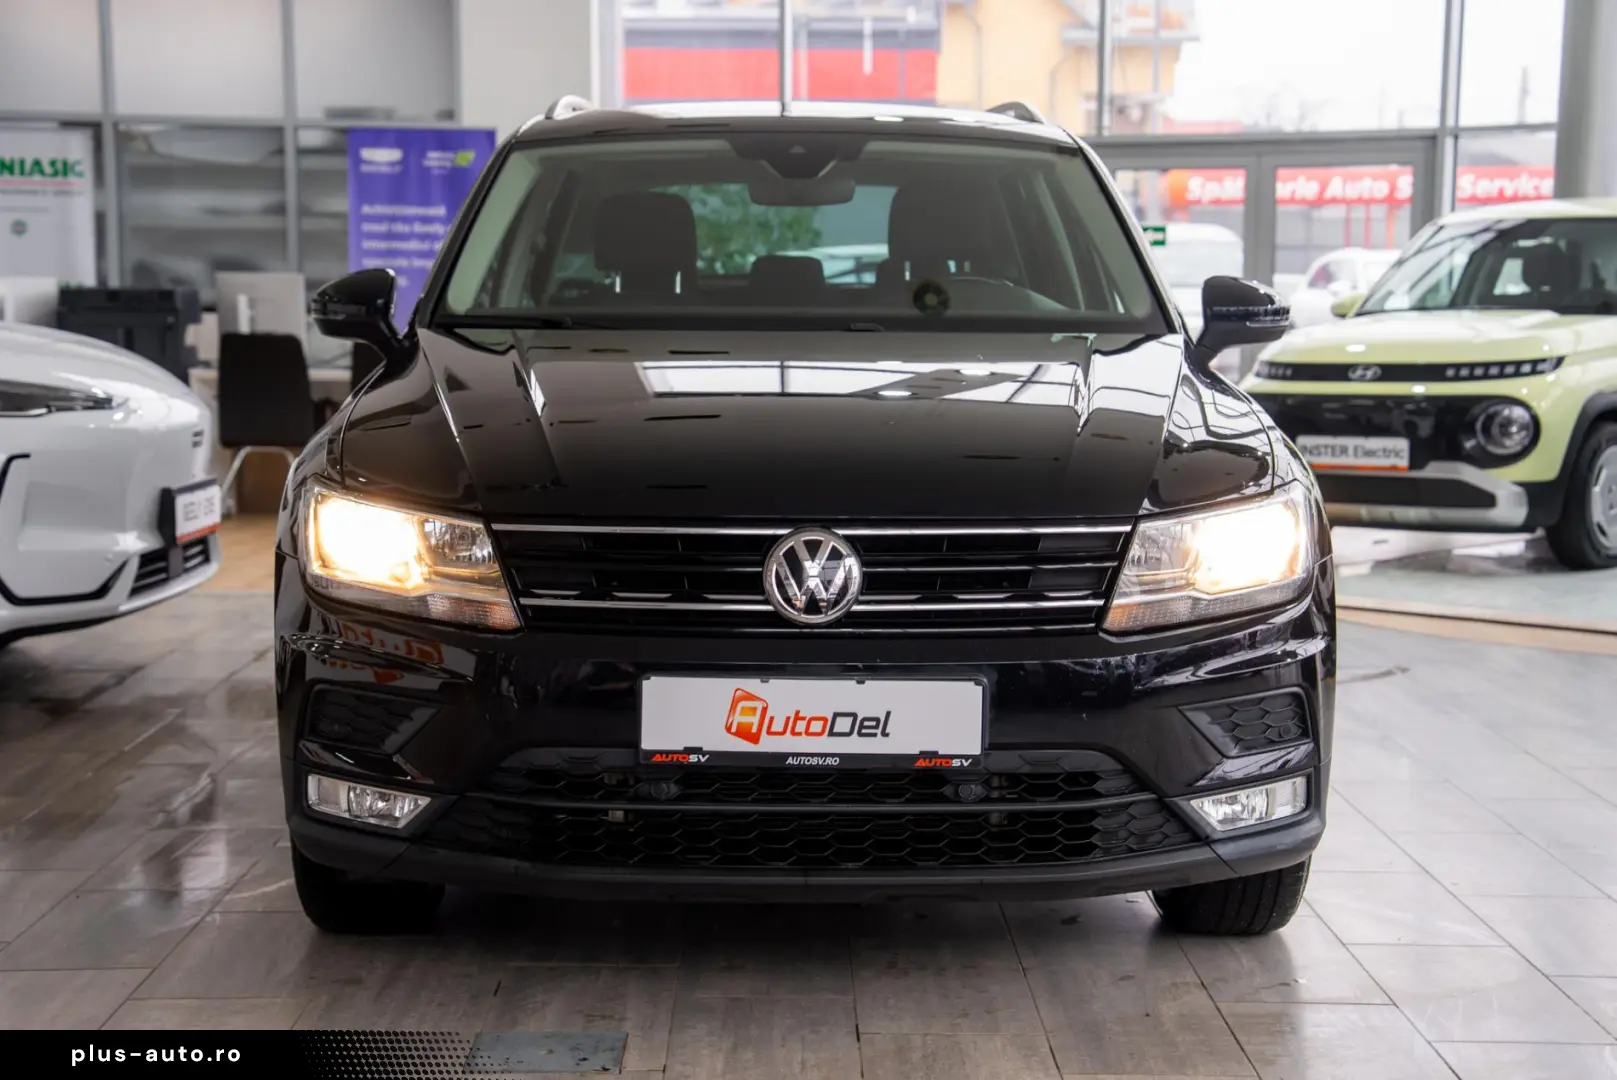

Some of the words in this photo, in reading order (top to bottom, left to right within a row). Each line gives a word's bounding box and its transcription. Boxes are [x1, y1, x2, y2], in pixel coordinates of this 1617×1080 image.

[1324, 174, 1390, 199] Auto
[1354, 444, 1405, 460] Electric
[727, 697, 892, 741] AutoDel
[651, 753, 710, 764] AUTOSV
[785, 756, 840, 767] AUTOSV.RO
[914, 757, 973, 768] AUTOSV
